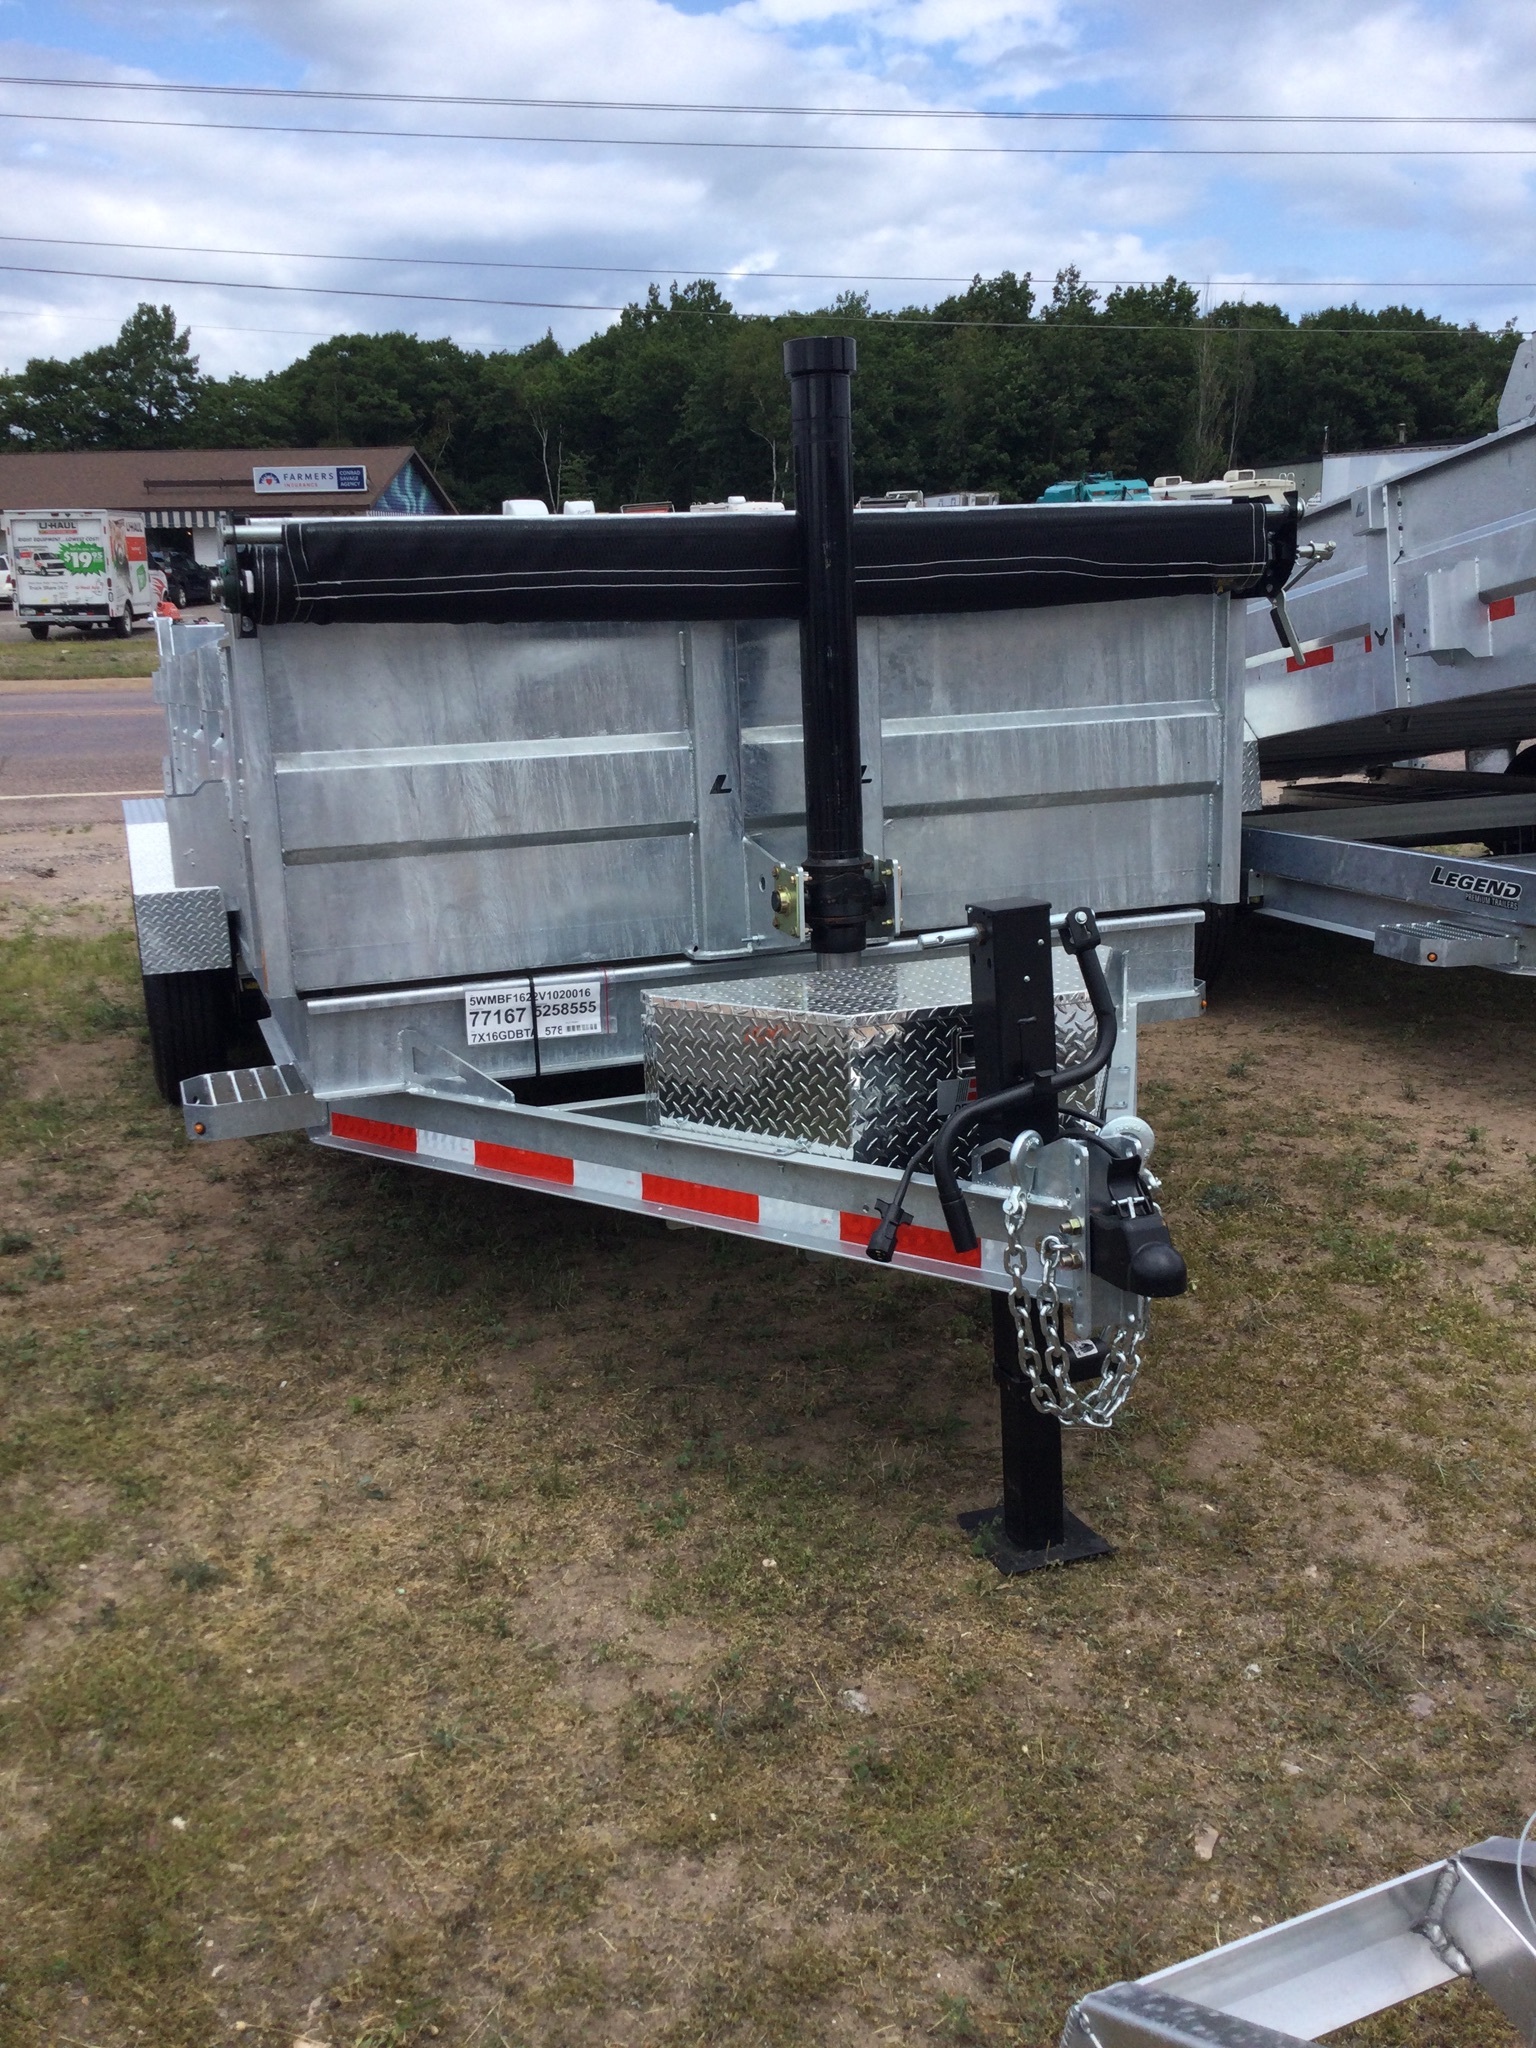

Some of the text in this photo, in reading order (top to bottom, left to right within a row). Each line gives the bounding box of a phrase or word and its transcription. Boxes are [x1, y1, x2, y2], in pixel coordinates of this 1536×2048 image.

[283, 472, 335, 481] FARMERS
[1430, 866, 1522, 900] LEGEND
[1465, 892, 1519, 911] PREMIUM TRAILERS
[469, 1001, 597, 1027] 77167 5258555
